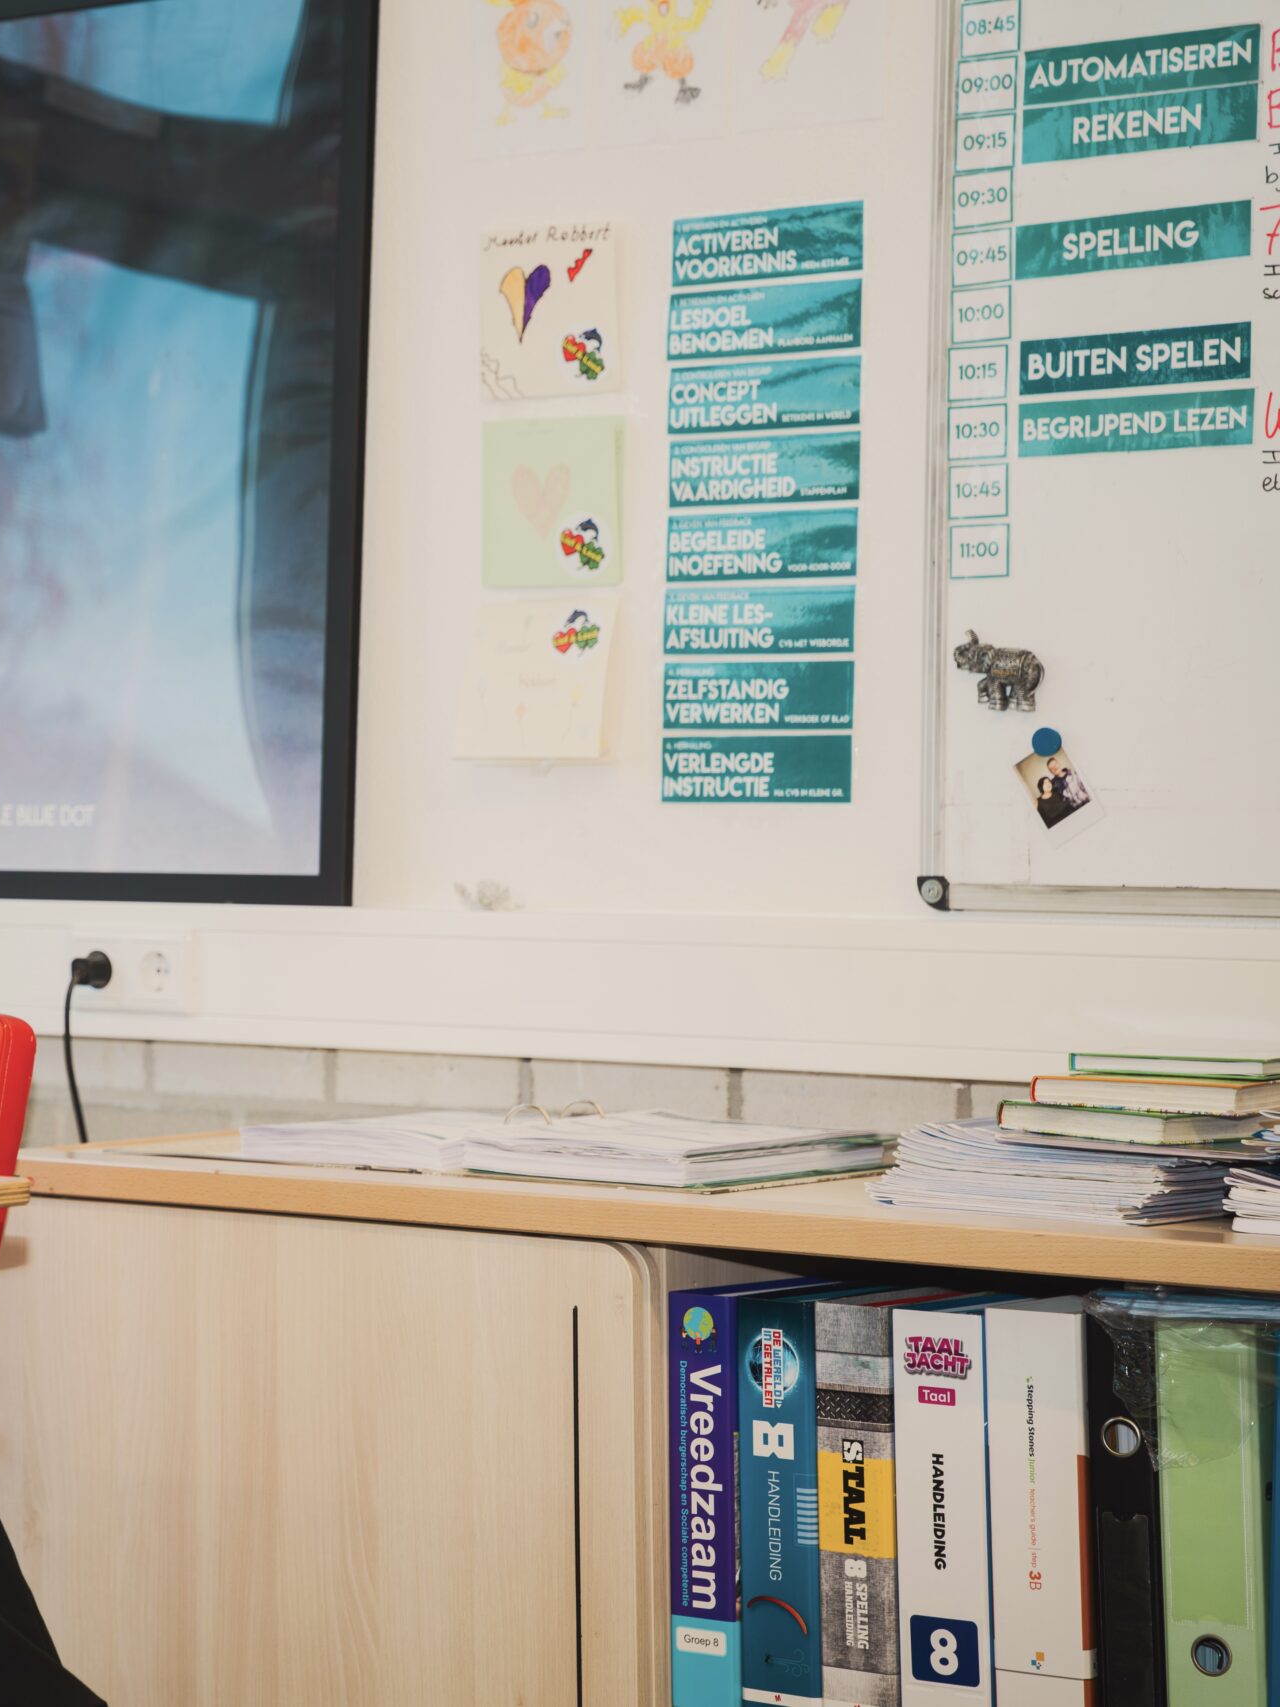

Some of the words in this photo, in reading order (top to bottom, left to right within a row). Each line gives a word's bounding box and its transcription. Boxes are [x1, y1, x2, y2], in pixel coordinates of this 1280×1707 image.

[965, 15, 1016, 37] 08:45
[1029, 38, 1253, 89] AUTOMATISEREN
[961, 74, 1013, 95] 09:00
[1072, 103, 1202, 145] REKENEN
[963, 131, 1007, 151] 09:15
[957, 187, 1008, 208] 09:30
[675, 226, 779, 257] ACTIVEREN
[1062, 220, 1200, 262] SPELLING
[675, 250, 798, 280] VOORKENNIS
[956, 244, 1008, 266] 09:45
[671, 305, 752, 331] LESDOEL
[958, 303, 1005, 324] 10:00
[670, 327, 774, 355] BENOEMEN
[1027, 346, 1127, 381] BUITEN
[1135, 336, 1241, 372] SPELEN
[958, 362, 998, 381] 10:15
[671, 379, 761, 404] CONCEPT
[670, 402, 778, 429] UITLEGGEN
[1022, 410, 1167, 442] BEGRIJPEND
[1174, 404, 1248, 434] LEZEN
[955, 421, 1000, 439] 10:30
[671, 452, 778, 479] INSTRUCTIE
[672, 476, 796, 502] VAARDIGHEID
[955, 480, 1001, 499] 10:45
[669, 528, 766, 552] BEGELEIDE
[959, 541, 999, 559] 11:00
[669, 551, 782, 577] INOEFENING
[666, 603, 729, 626] KLEINE
[732, 603, 773, 625] LES-
[666, 627, 775, 649] AFSLUITING
[665, 678, 790, 700] ZELFSTANDIG
[665, 702, 780, 724] VERWERKEN
[664, 752, 775, 774] VERLENGDE
[663, 776, 770, 798] INSTRUCTIE
[59, 804, 96, 828] DOT
[773, 1331, 782, 1346] DE
[907, 1336, 965, 1357] TAAL
[773, 1348, 782, 1398] WERELD
[905, 1352, 969, 1375] JACHT
[679, 1360, 687, 1427] Democratisch
[922, 1389, 951, 1403] Taal
[1026, 1384, 1034, 1426] Stepping
[752, 1420, 795, 1460] 8
[678, 1430, 688, 1491] burgerschap
[681, 1493, 687, 1506] en
[689, 1364, 723, 1610] Vreedzaam
[842, 1438, 866, 1545] STAAL
[932, 1453, 947, 1571] HANDLEIDING
[681, 1508, 689, 1544] Sociale
[767, 1470, 782, 1581] HANDLEIDING
[1029, 1524, 1037, 1545] guide
[679, 1546, 689, 1607] competentie
[844, 1558, 867, 1579] 8
[1029, 1571, 1042, 1591] 3B
[844, 1581, 855, 1647] HANDLEIDING
[855, 1583, 869, 1650] SPELLING
[683, 1633, 711, 1648] Groep
[713, 1637, 719, 1647] 8
[929, 1628, 959, 1677] 8
